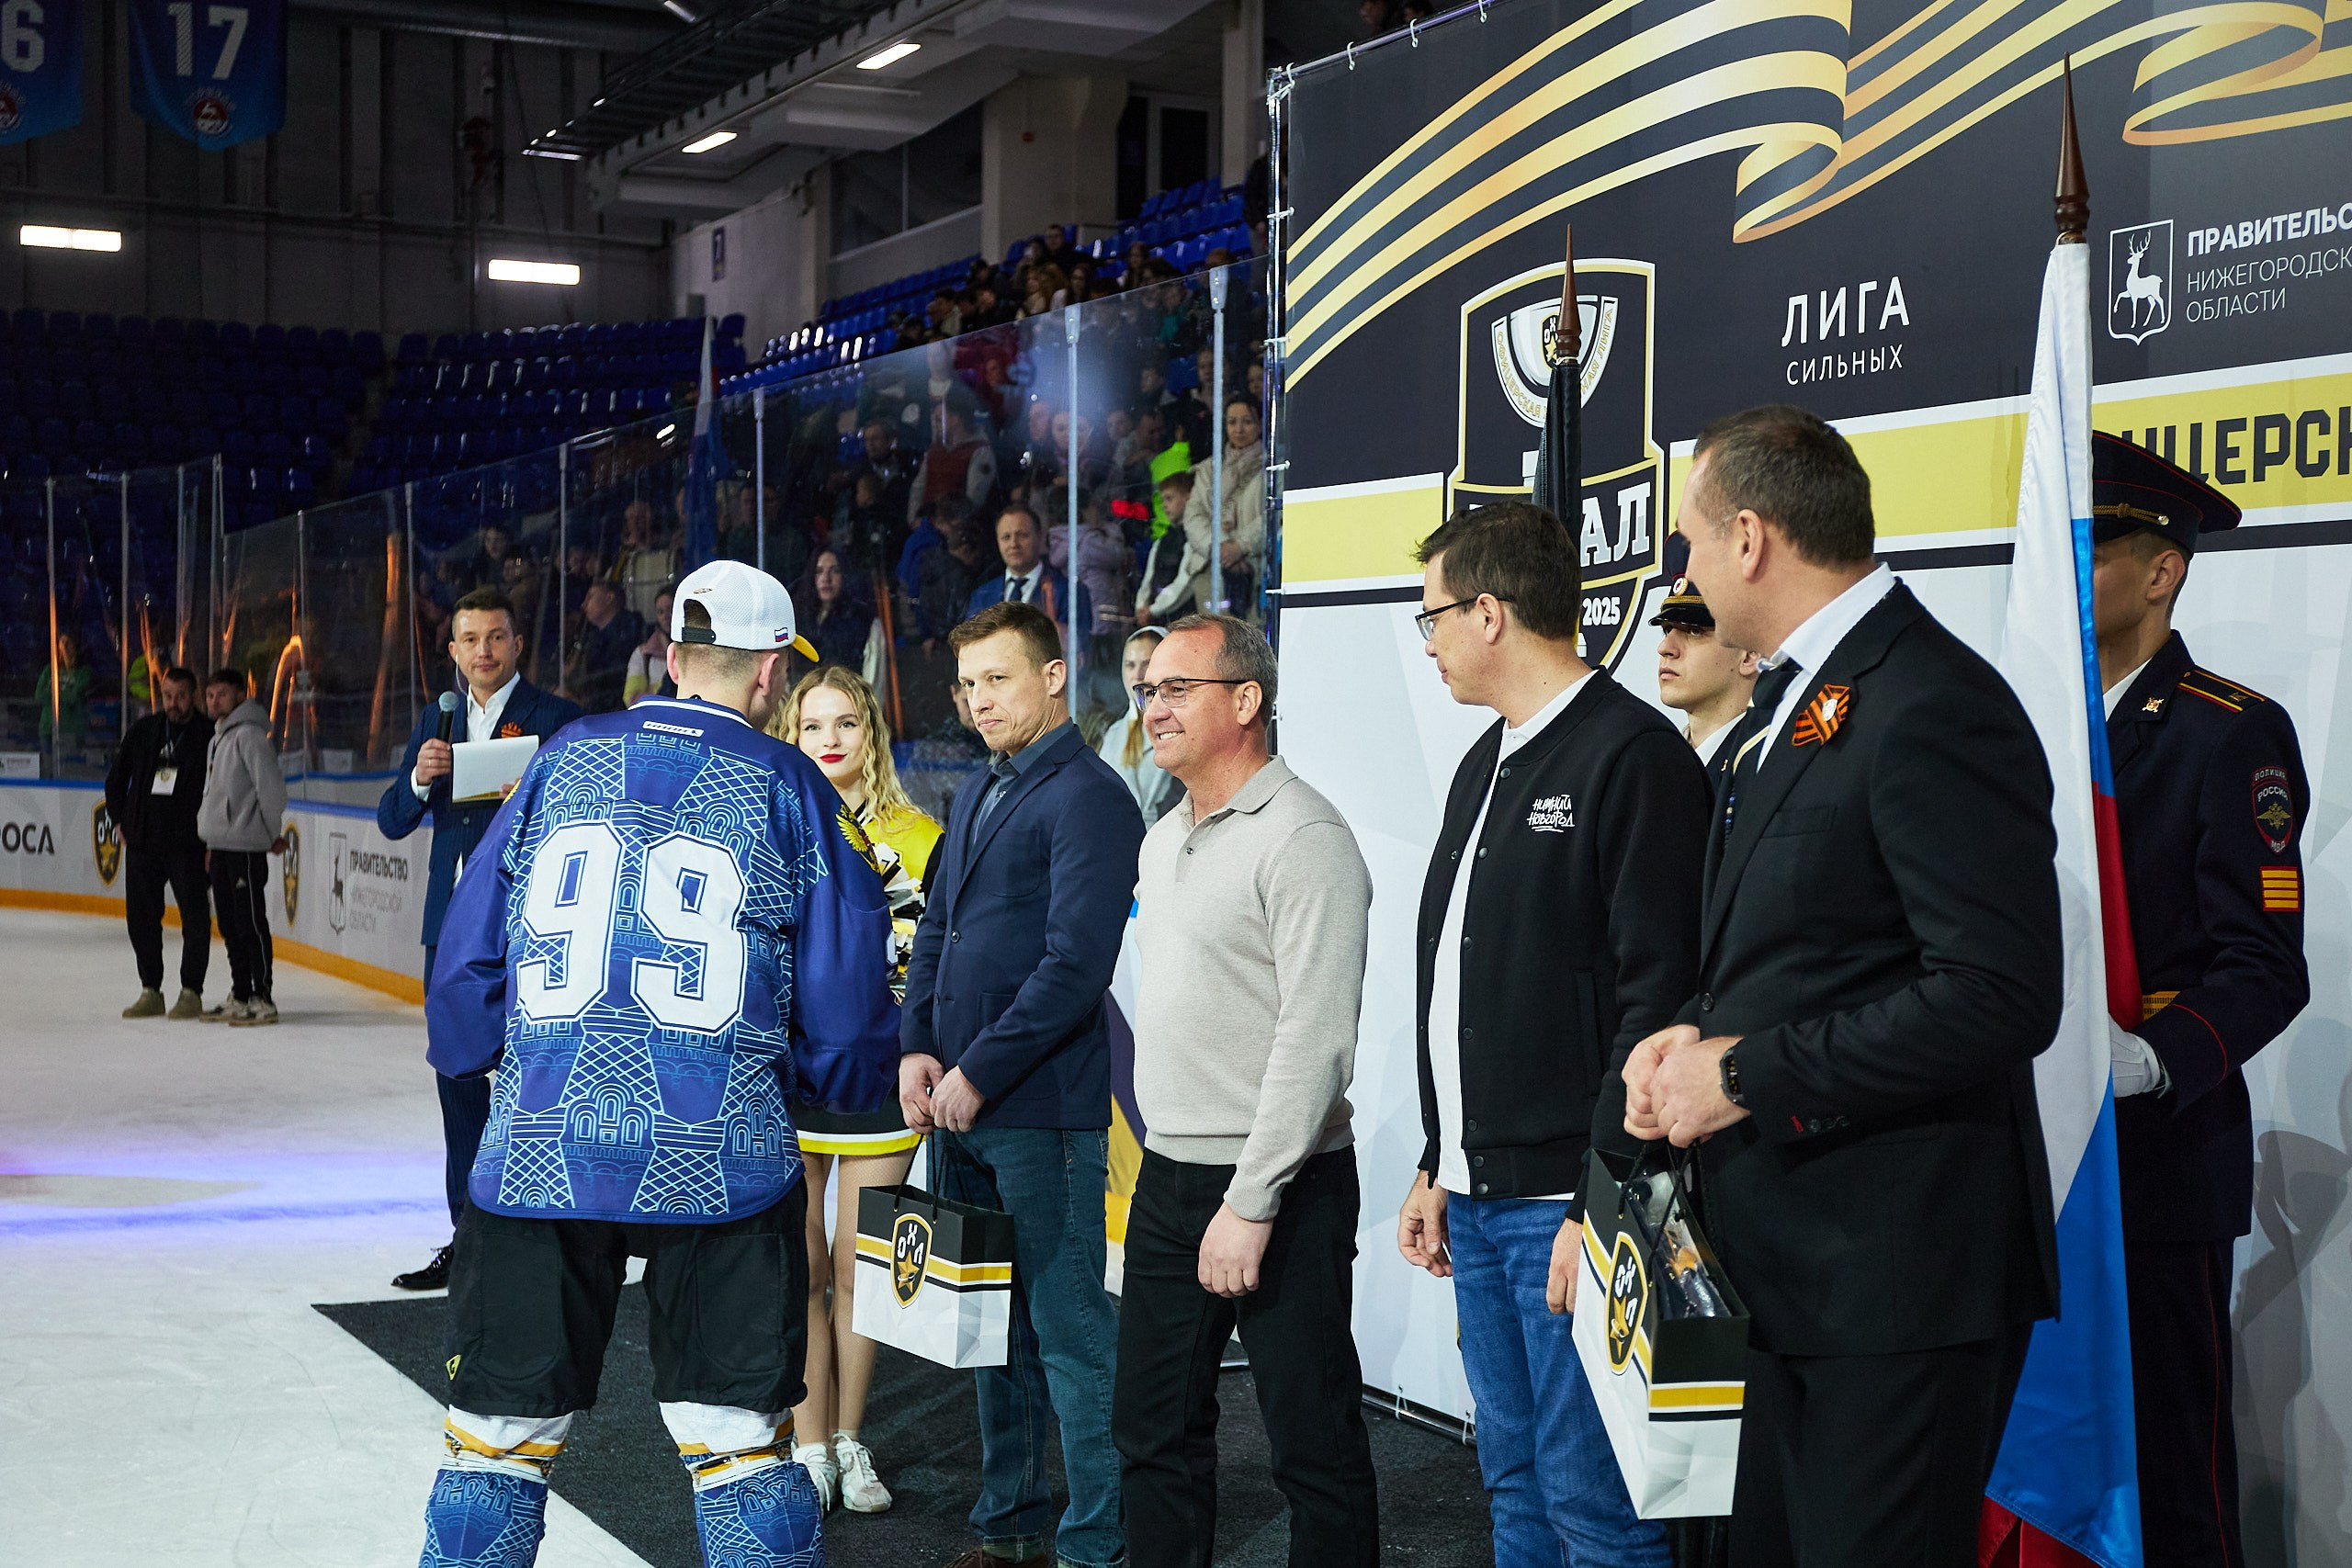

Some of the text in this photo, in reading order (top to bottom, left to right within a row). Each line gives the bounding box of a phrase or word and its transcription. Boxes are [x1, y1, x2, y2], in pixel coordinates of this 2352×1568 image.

[167, 2, 249, 81] 17
[2187, 202, 2352, 257] ПРАВИТЕЛЬС
[2186, 245, 2352, 294] НИЖЕГОРОДСК
[1781, 276, 1910, 347] ЛИГА
[2186, 288, 2287, 322] ОБЛАСТИ
[1786, 344, 1903, 386] СИЛЬНЫХ
[1582, 597, 1621, 626] 2025
[2254, 768, 2287, 782] ПОЛИЦИЯ
[2257, 786, 2289, 802] РОССИЯ
[0, 821, 55, 855] ОСА
[2270, 840, 2286, 853] МВД
[349, 850, 408, 882] ПРАВИТЕЛЬСТВО
[515, 818, 748, 1036] 99
